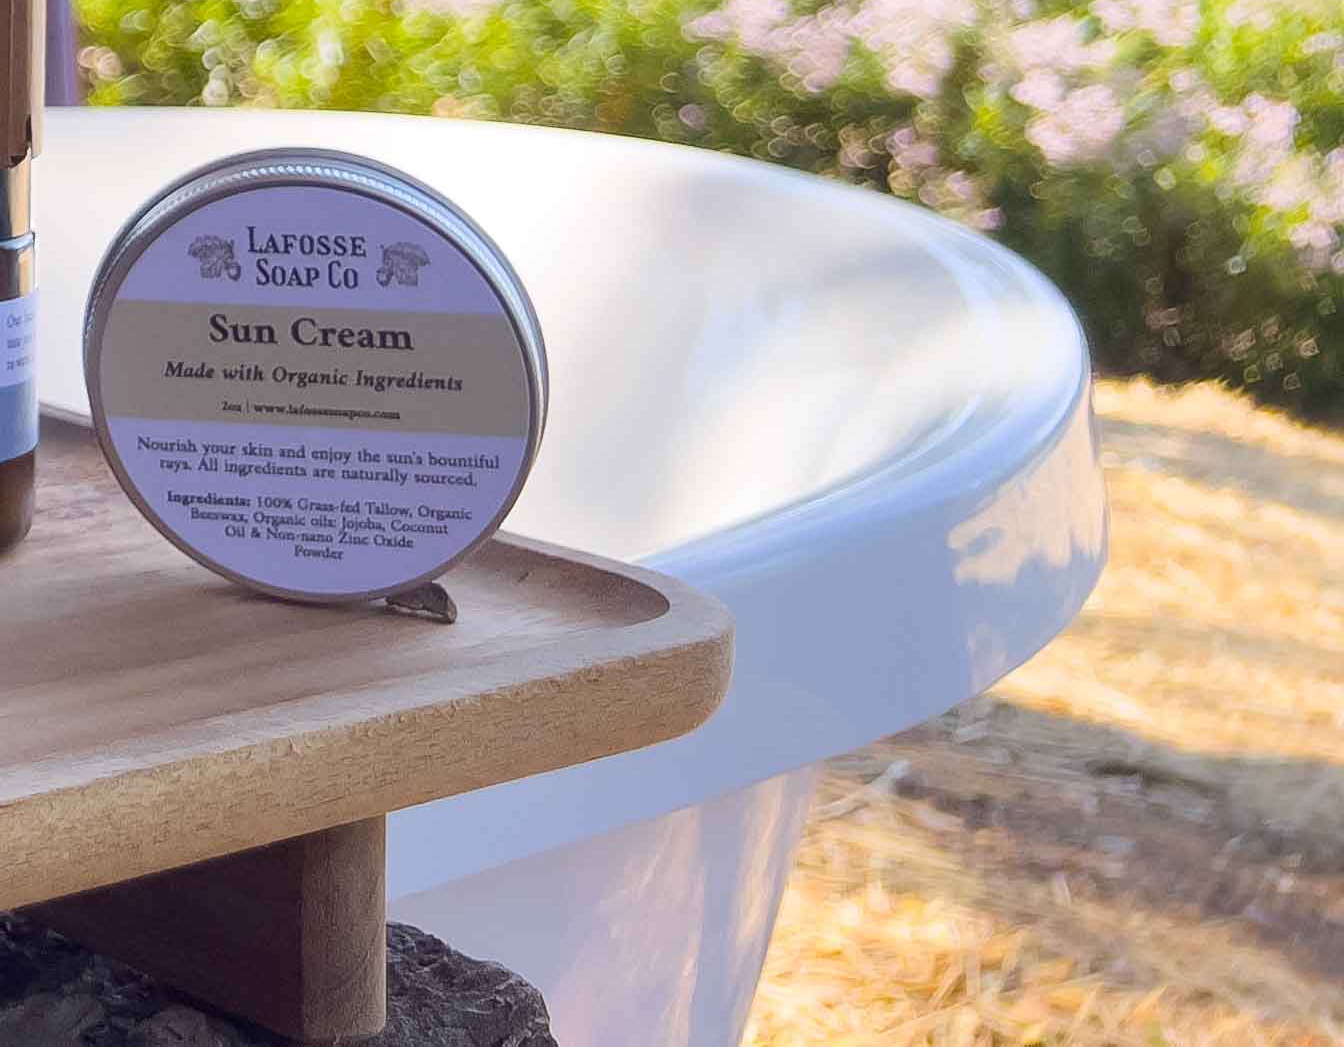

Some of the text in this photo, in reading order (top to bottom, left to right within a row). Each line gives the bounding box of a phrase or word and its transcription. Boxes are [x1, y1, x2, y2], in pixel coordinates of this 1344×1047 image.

[209, 314, 415, 351] Sun Cream
[164, 361, 463, 392] Made with Organic Ingredients
[137, 435, 500, 469] Nourish your skin and enjoy the sun's bountiful
[197, 457, 218, 472] All
[223, 459, 308, 477] ingredients
[312, 467, 336, 479] are
[341, 469, 408, 486] naturally
[167, 490, 251, 507] Ingredients:
[256, 496, 293, 509] 100%
[366, 501, 412, 518] Tallow,
[417, 505, 472, 522] Organic
[224, 525, 245, 539] Oil
[250, 529, 261, 540] &
[338, 531, 369, 546] Zinc
[373, 534, 414, 548] Oxide
[253, 511, 306, 527] Organic
[391, 519, 448, 534] Coconut
